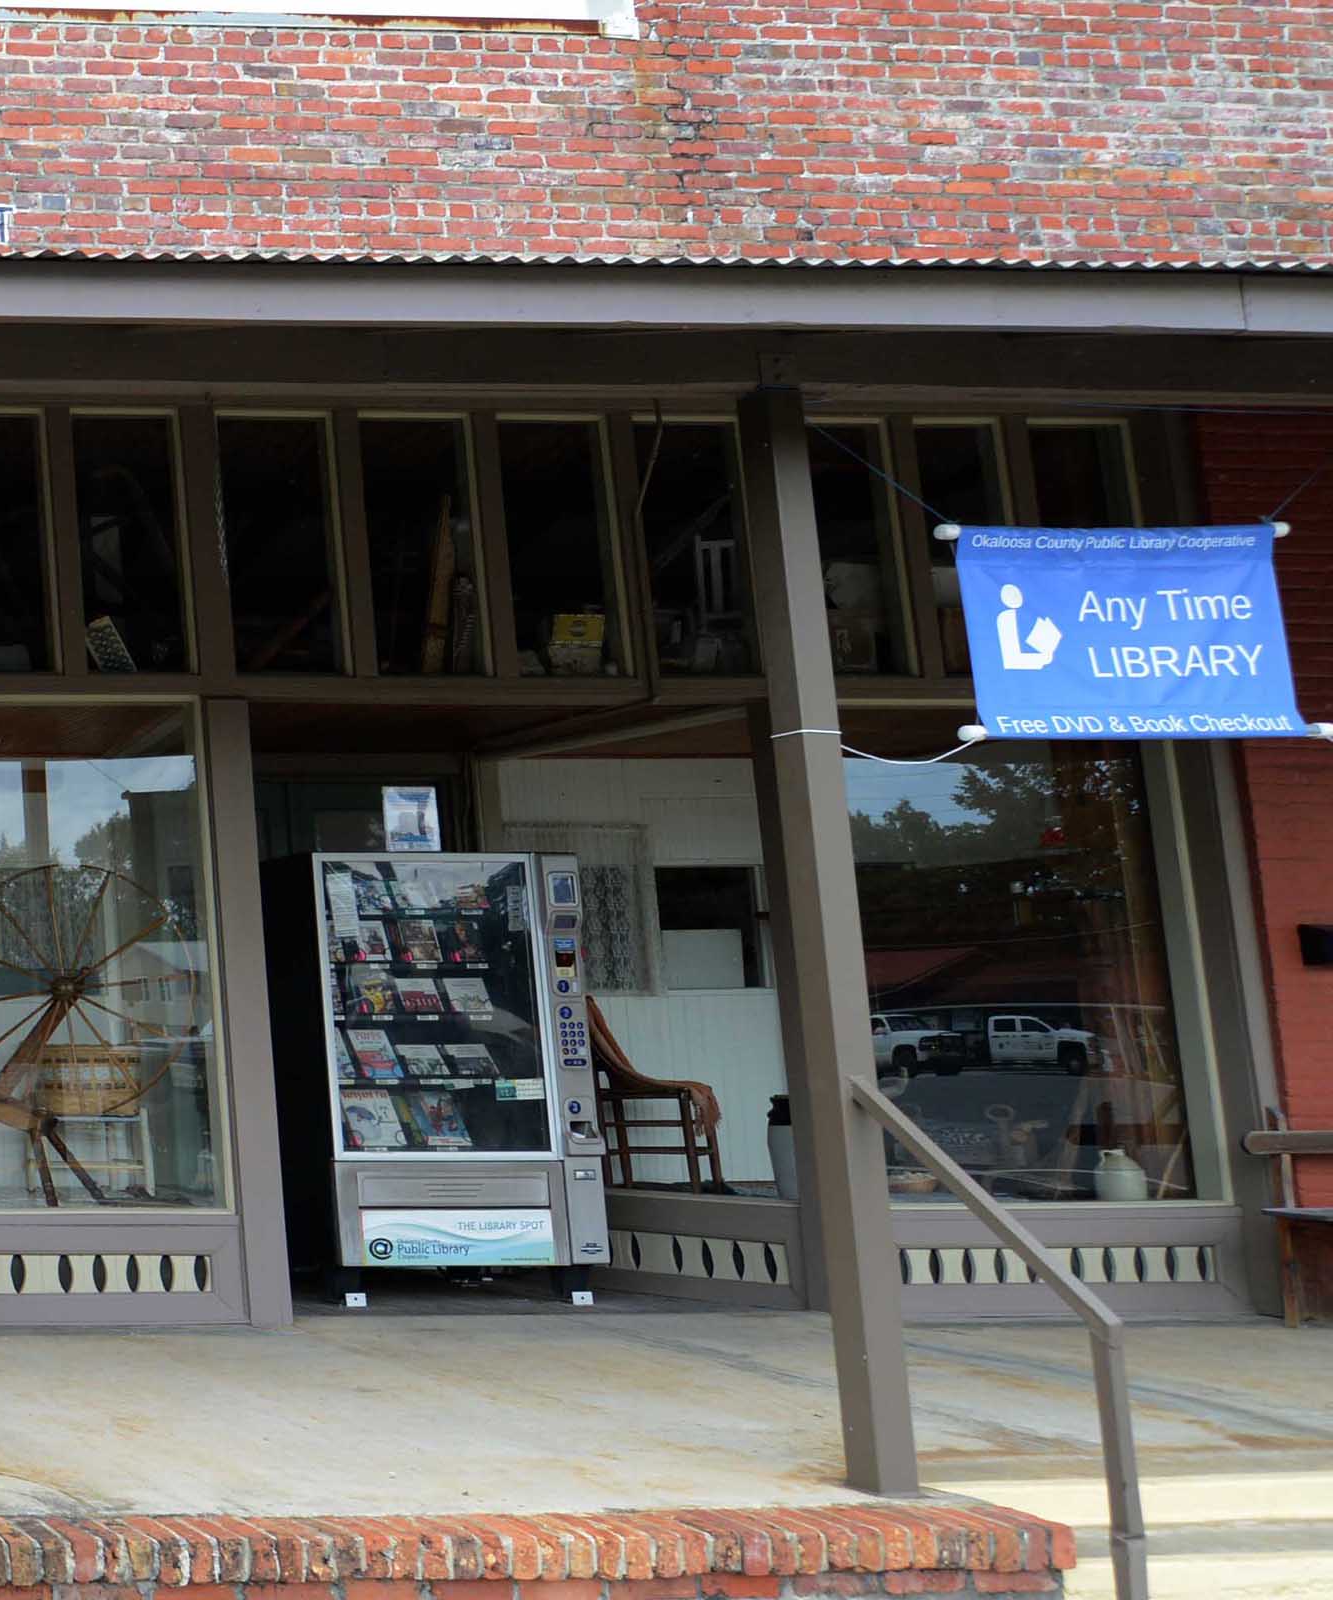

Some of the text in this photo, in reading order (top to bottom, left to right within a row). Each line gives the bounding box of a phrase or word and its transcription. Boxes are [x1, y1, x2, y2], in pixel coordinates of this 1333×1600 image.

[971, 534, 1255, 552] Okaloosa County Public Library Cooperative
[1078, 587, 1252, 630] Any Time
[1087, 644, 1263, 678] LIBRARY
[996, 713, 1293, 734] Free DVD & Book Checkout
[457, 1220, 545, 1231] THE LIBRARY SPOT
[397, 1244, 470, 1257] Public Library
